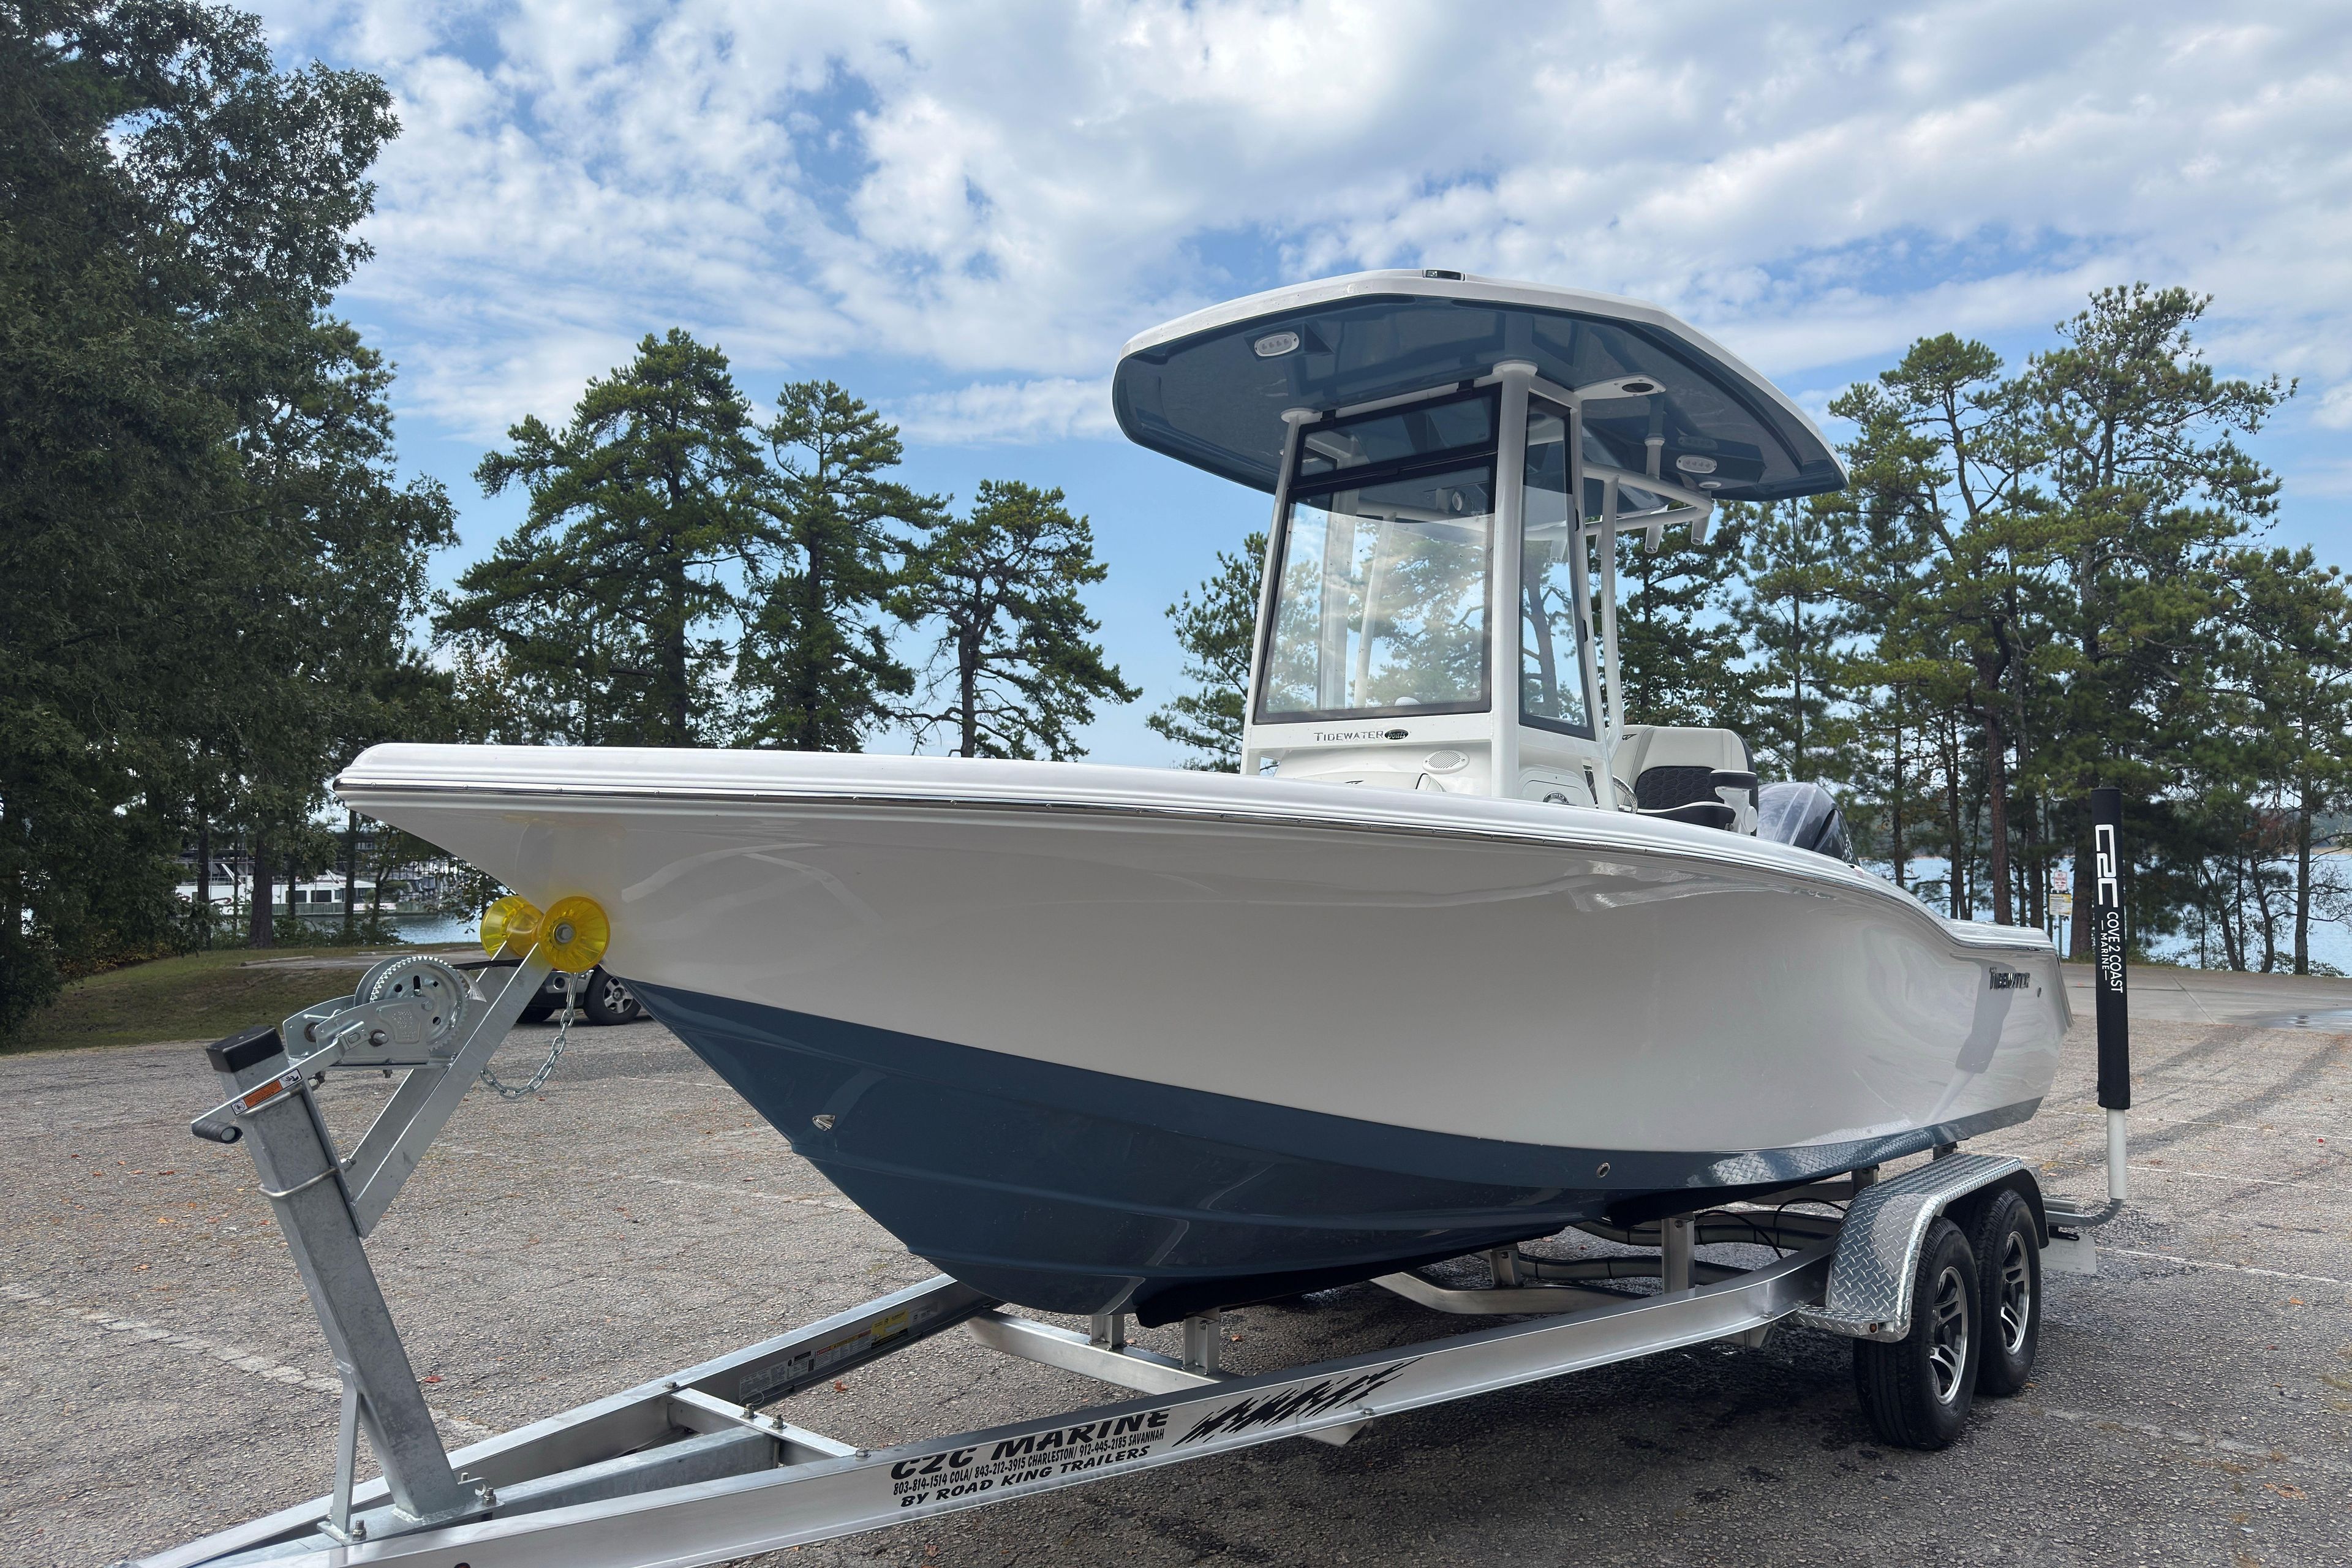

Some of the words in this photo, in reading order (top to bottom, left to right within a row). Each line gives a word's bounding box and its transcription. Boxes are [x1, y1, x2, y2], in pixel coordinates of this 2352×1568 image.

[1314, 731, 1384, 742] TIDEWATER
[2106, 911, 2120, 943] COVE
[2100, 933, 2109, 970] MARINE
[2109, 952, 2123, 993] COAST
[891, 1447, 978, 1480] C2C
[990, 1408, 1171, 1461] MARINE
[893, 1473, 948, 1495] 803-814-1514
[974, 1457, 1026, 1479] 843-212-3915
[1080, 1438, 1126, 1457] 912-445-2185
[1128, 1428, 1165, 1447] SAVANNAH
[900, 1492, 930, 1507] BY
[935, 1479, 993, 1501] ROAD
[1000, 1466, 1052, 1487] KING
[1060, 1445, 1150, 1474] TRAILERS
